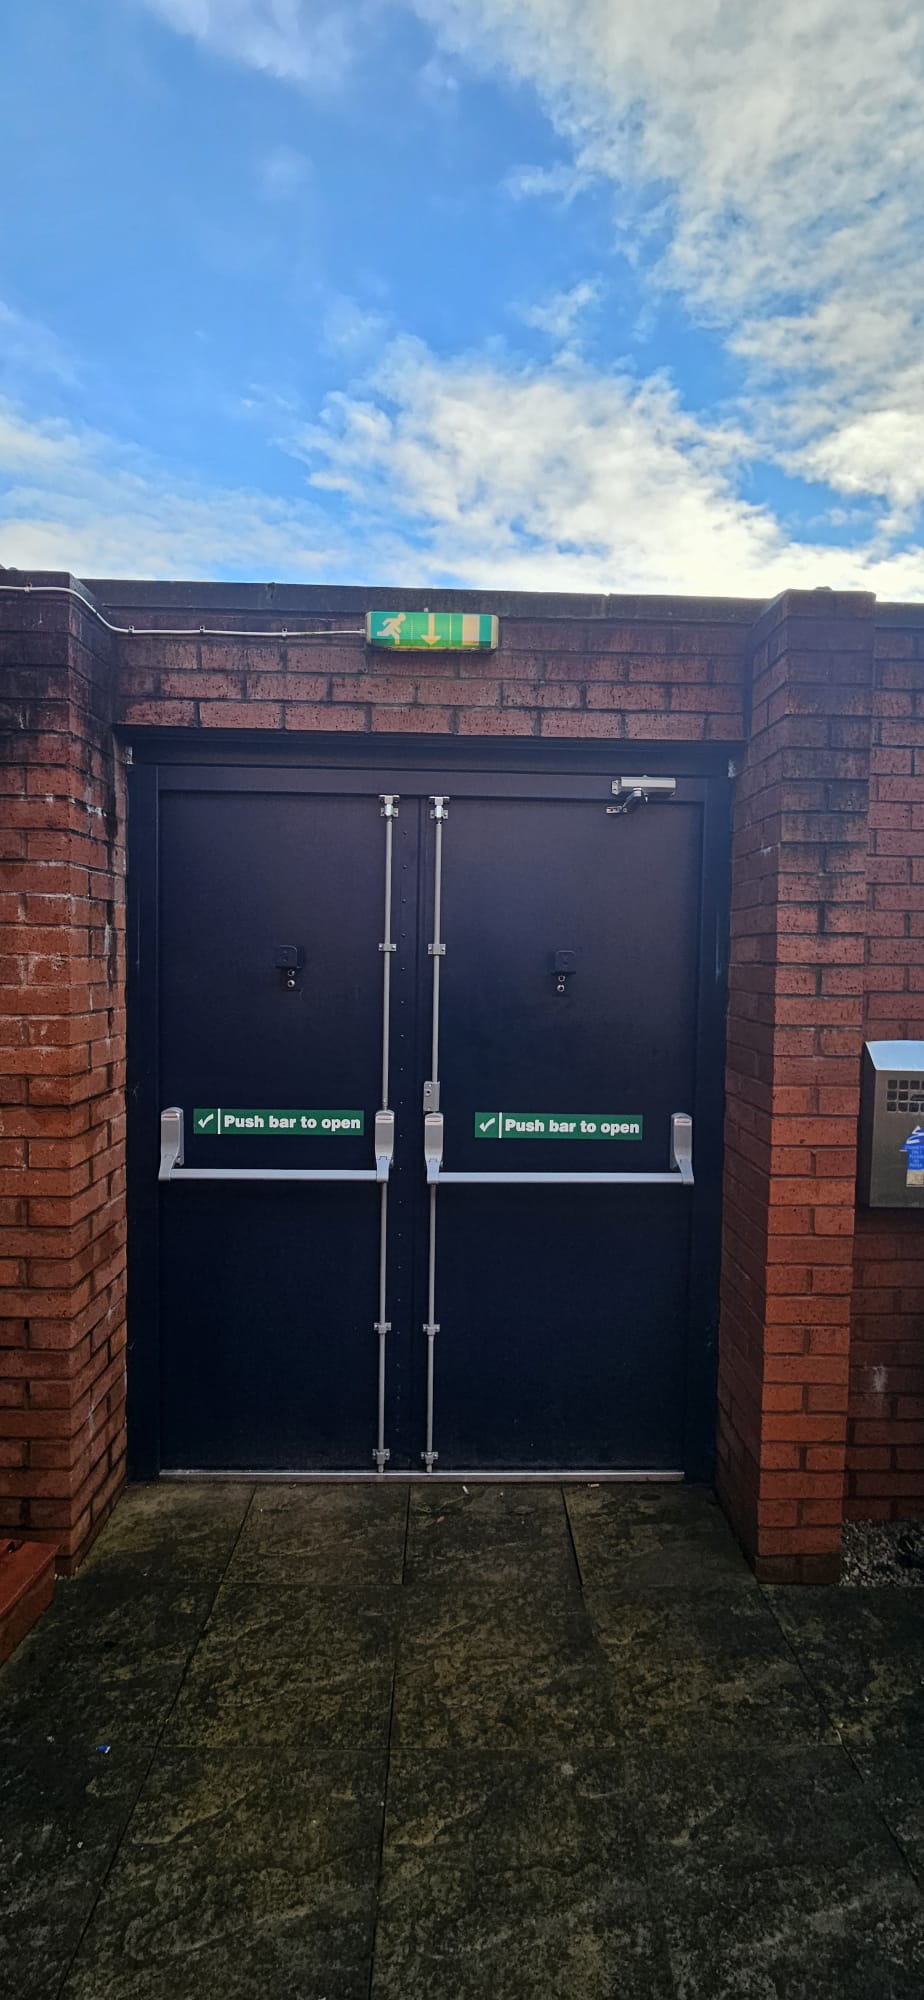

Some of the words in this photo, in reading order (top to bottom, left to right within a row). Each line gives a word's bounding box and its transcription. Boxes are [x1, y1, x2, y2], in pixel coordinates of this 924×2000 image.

[224, 1115, 264, 1128] Push
[268, 1116, 296, 1129] bar
[301, 1116, 317, 1129] to
[321, 1118, 361, 1132] open
[505, 1119, 545, 1133] Push
[549, 1120, 576, 1133] bar
[580, 1121, 596, 1133] to
[601, 1123, 640, 1137] open
